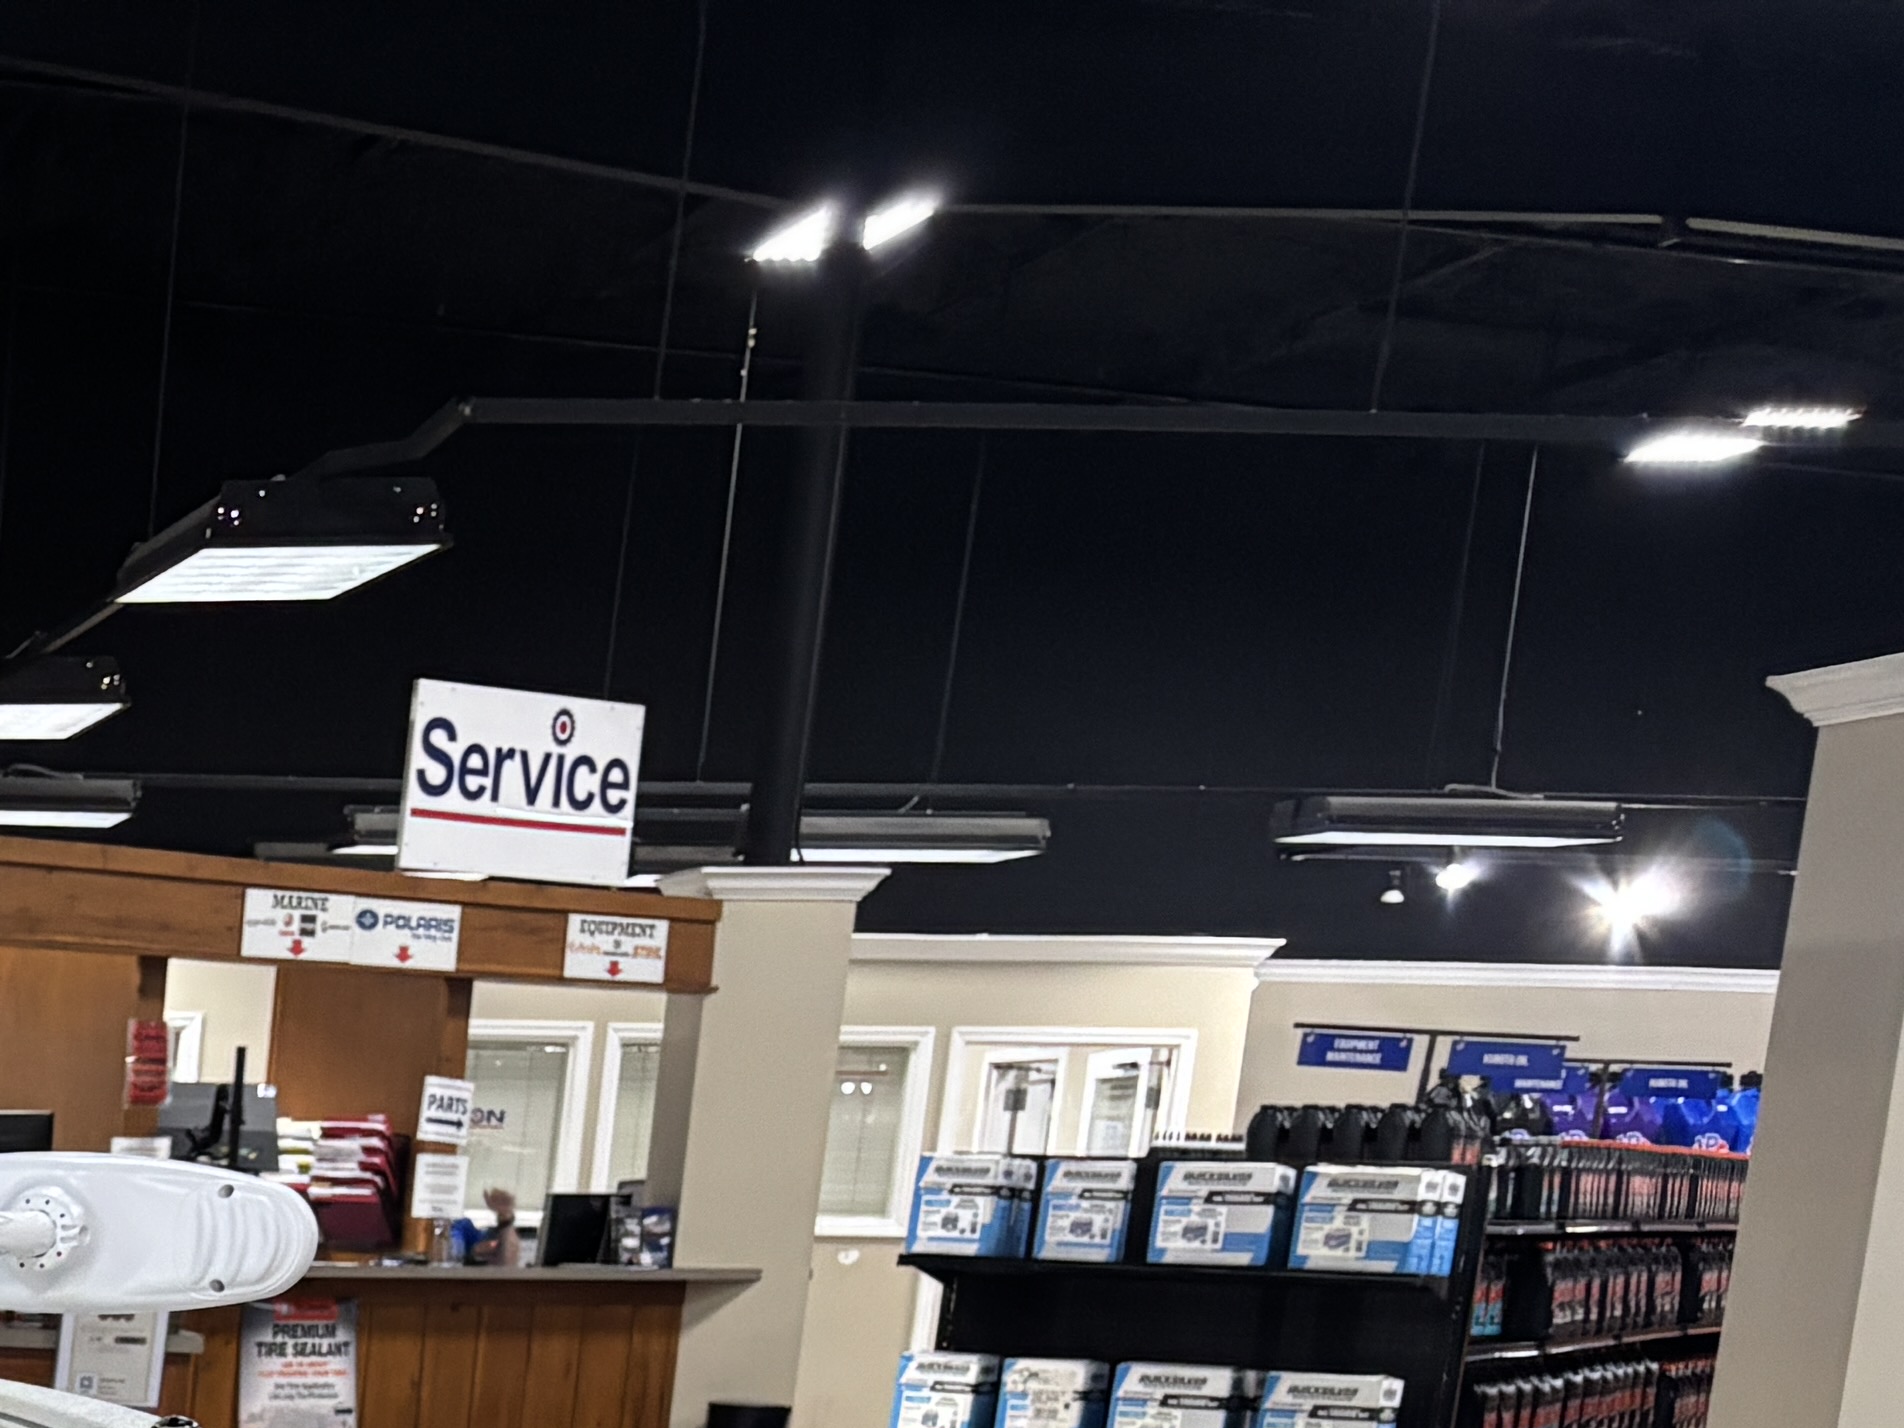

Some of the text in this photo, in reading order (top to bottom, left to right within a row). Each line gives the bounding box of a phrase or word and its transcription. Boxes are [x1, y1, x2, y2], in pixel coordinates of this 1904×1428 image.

[416, 708, 630, 814] Service
[272, 894, 329, 912] MARINE
[382, 913, 455, 934] POLARIS
[579, 918, 656, 939] EQUIPMENT
[427, 1093, 468, 1116] PARTS
[272, 1323, 337, 1340] PREMIUM
[255, 1340, 351, 1358] TIRE SEALANT
